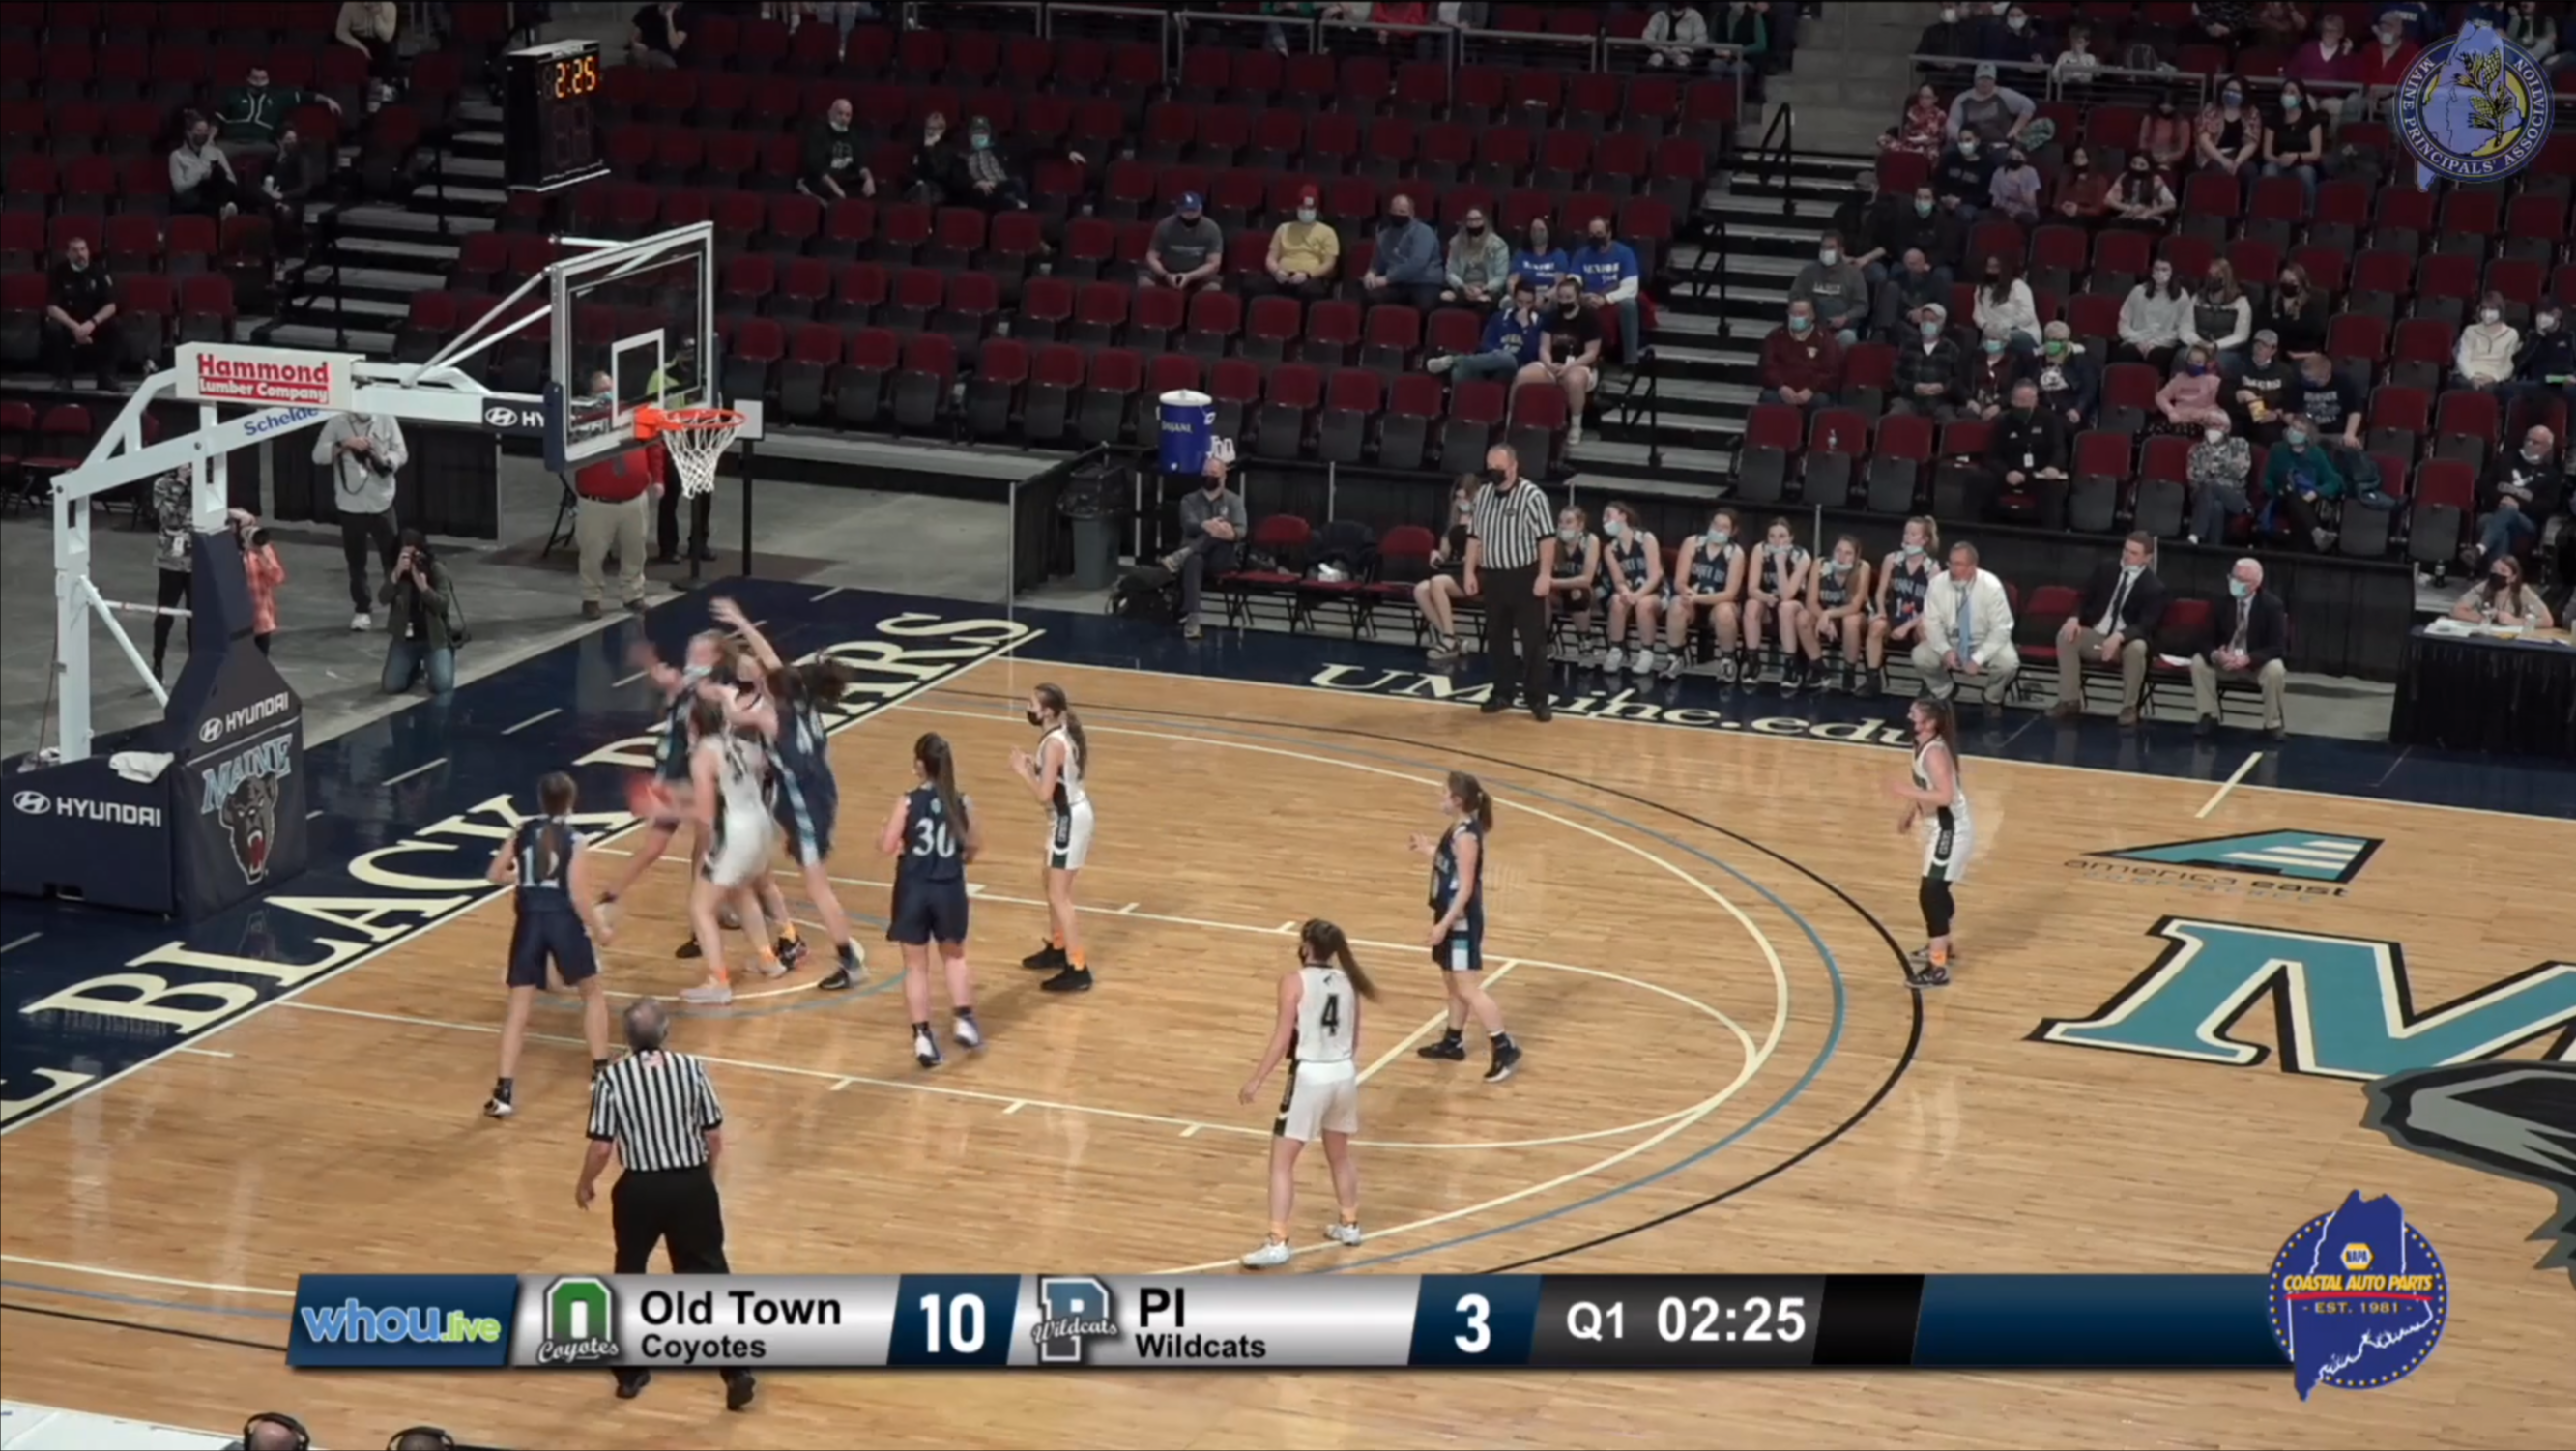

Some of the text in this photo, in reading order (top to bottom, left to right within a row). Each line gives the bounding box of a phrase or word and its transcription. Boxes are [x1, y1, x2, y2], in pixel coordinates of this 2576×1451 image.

[554, 56, 595, 98] 2:25
[197, 353, 330, 383] Hammond
[199, 378, 329, 403] Lumber Company
[244, 407, 319, 436] Schelde
[225, 691, 289, 732] HYUNDAI
[201, 733, 292, 814] MAINE
[57, 797, 161, 827] HYUNDAI
[912, 817, 955, 858] 30
[521, 844, 560, 888] 12
[2063, 859, 2352, 898] america east
[1321, 993, 1340, 1038] 4
